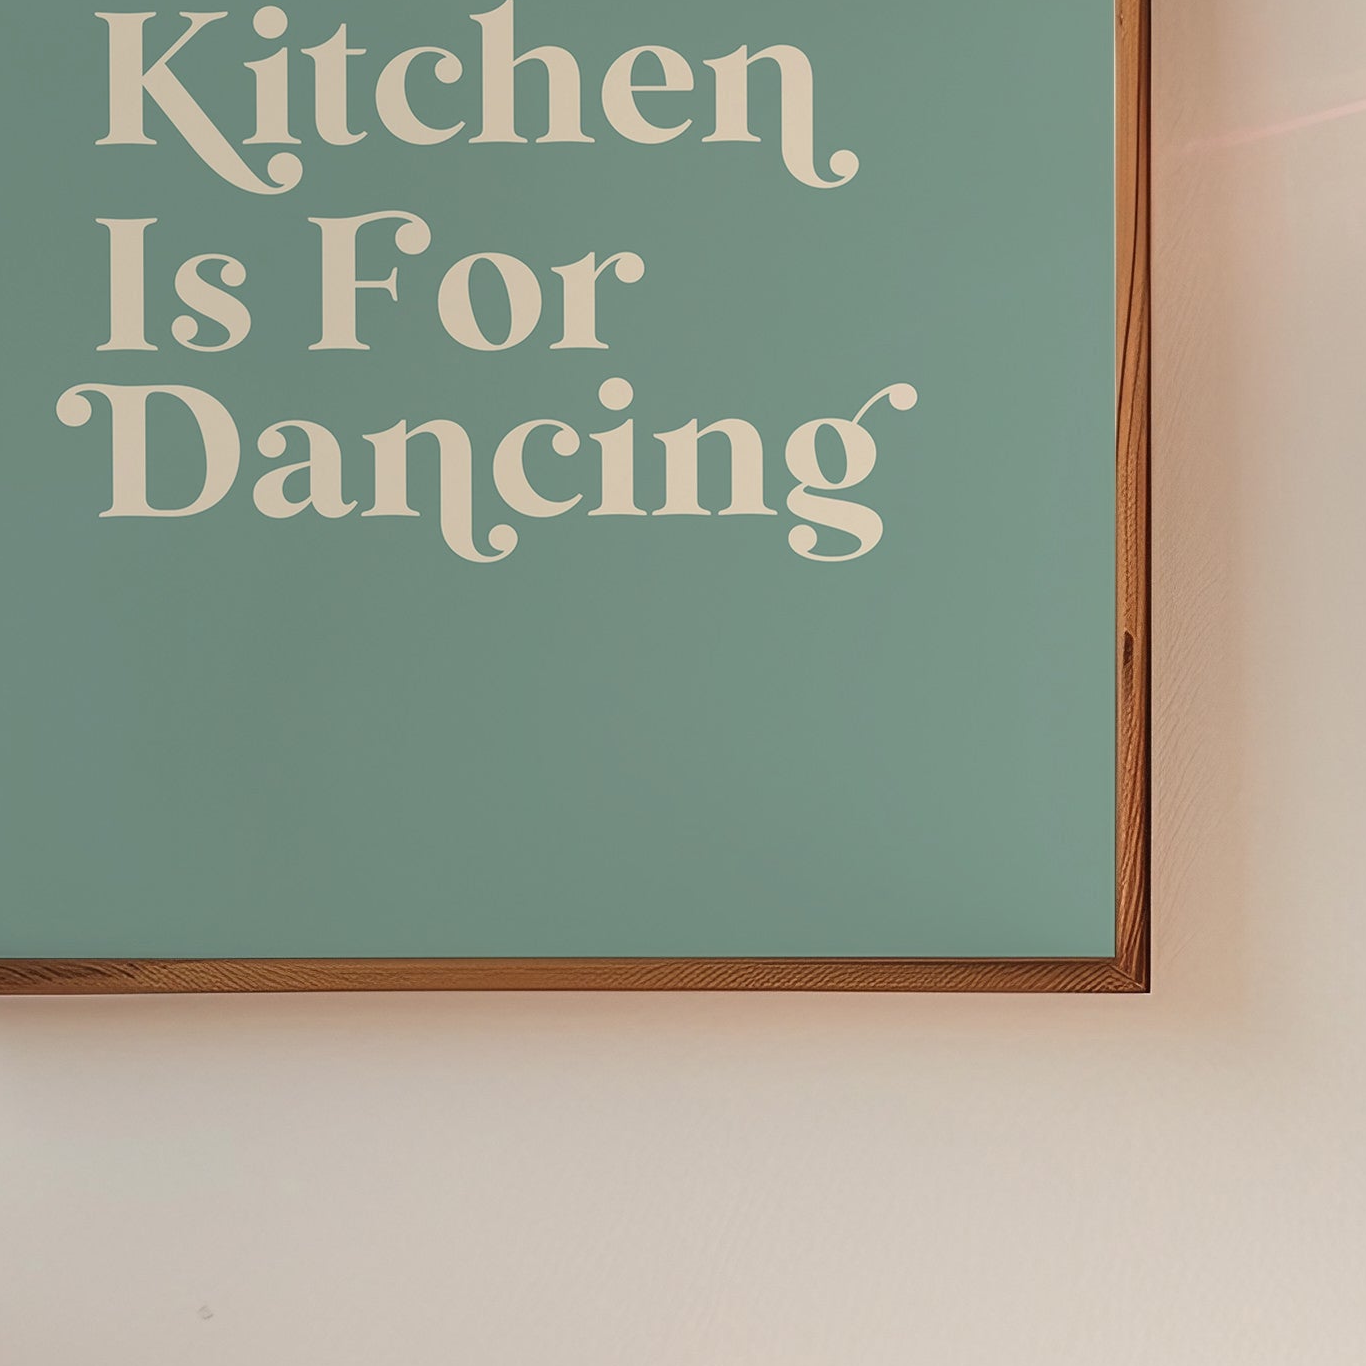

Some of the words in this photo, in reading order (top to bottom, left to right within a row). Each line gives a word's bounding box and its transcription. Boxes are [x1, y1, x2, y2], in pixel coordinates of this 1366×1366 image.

[95, 217, 252, 352] Is
[307, 210, 645, 352] For
[56, 377, 918, 563] Dancing
